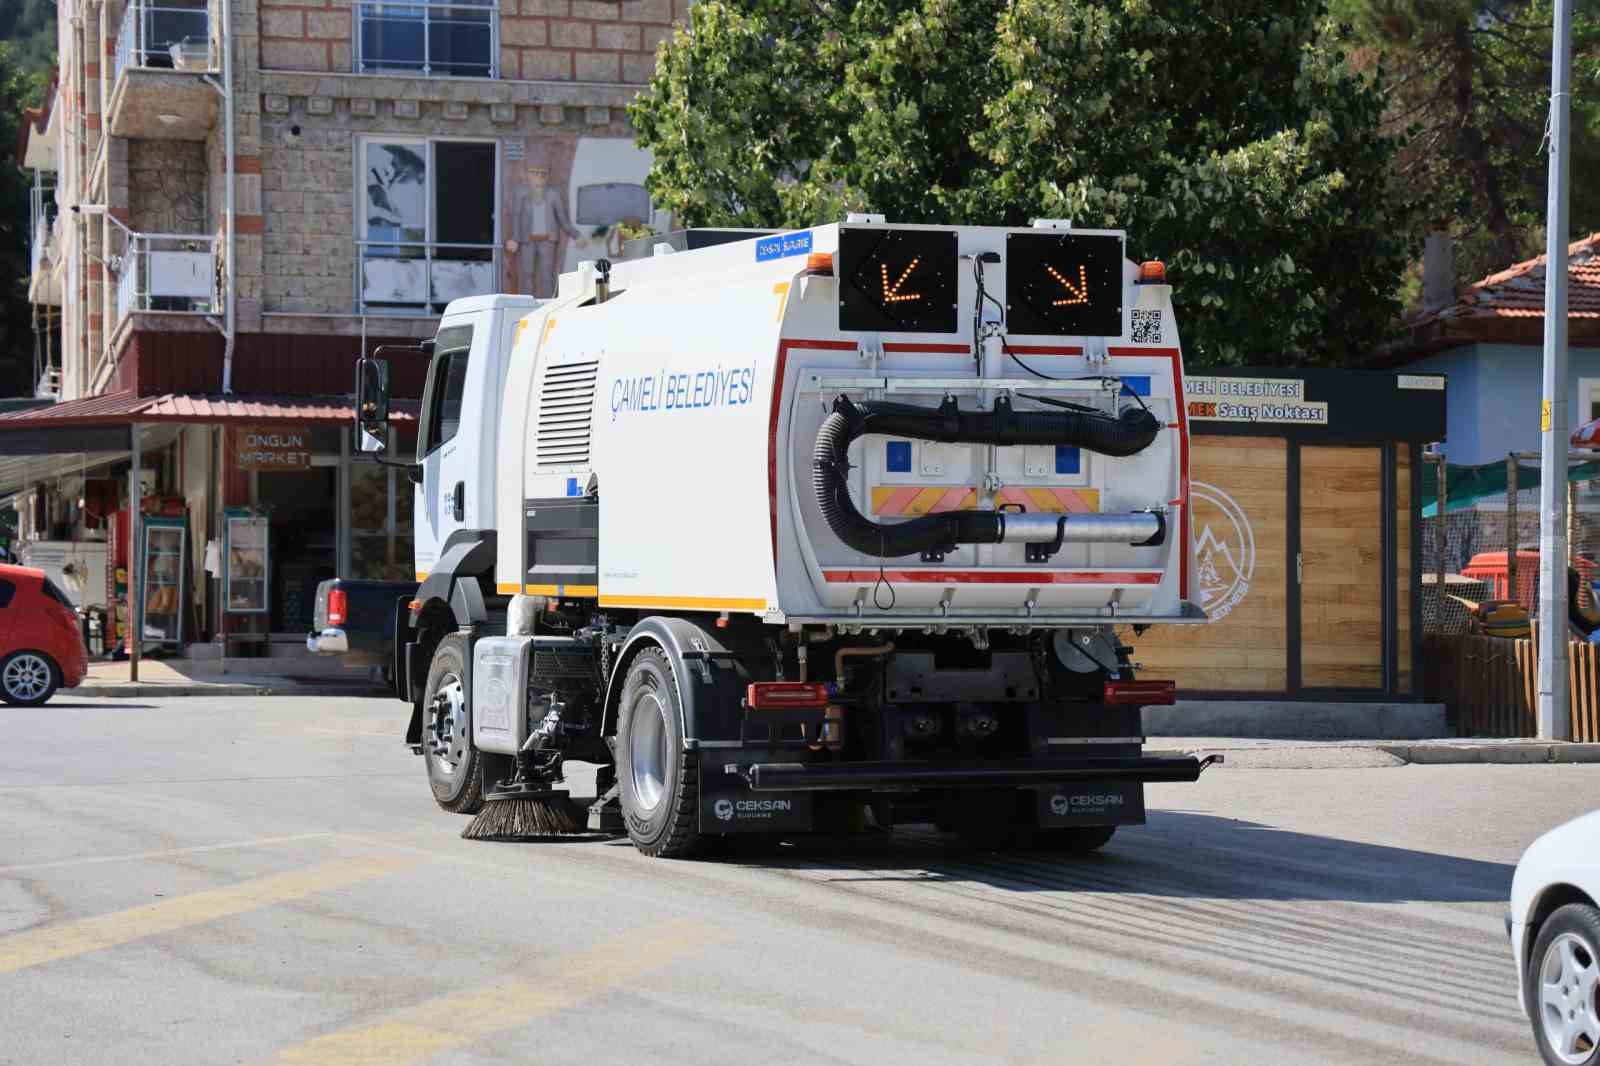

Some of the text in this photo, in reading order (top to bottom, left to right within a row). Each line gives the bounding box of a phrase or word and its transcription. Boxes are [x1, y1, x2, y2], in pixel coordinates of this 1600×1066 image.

[611, 359, 758, 422] ÇAMELİ BELEDİYESİ
[1184, 378, 1300, 398] MELİ BELEDİYESİ
[1188, 402, 1324, 421] MEK Satış Noktası
[240, 451, 309, 464] MARKET
[736, 799, 792, 811] CEKSAN
